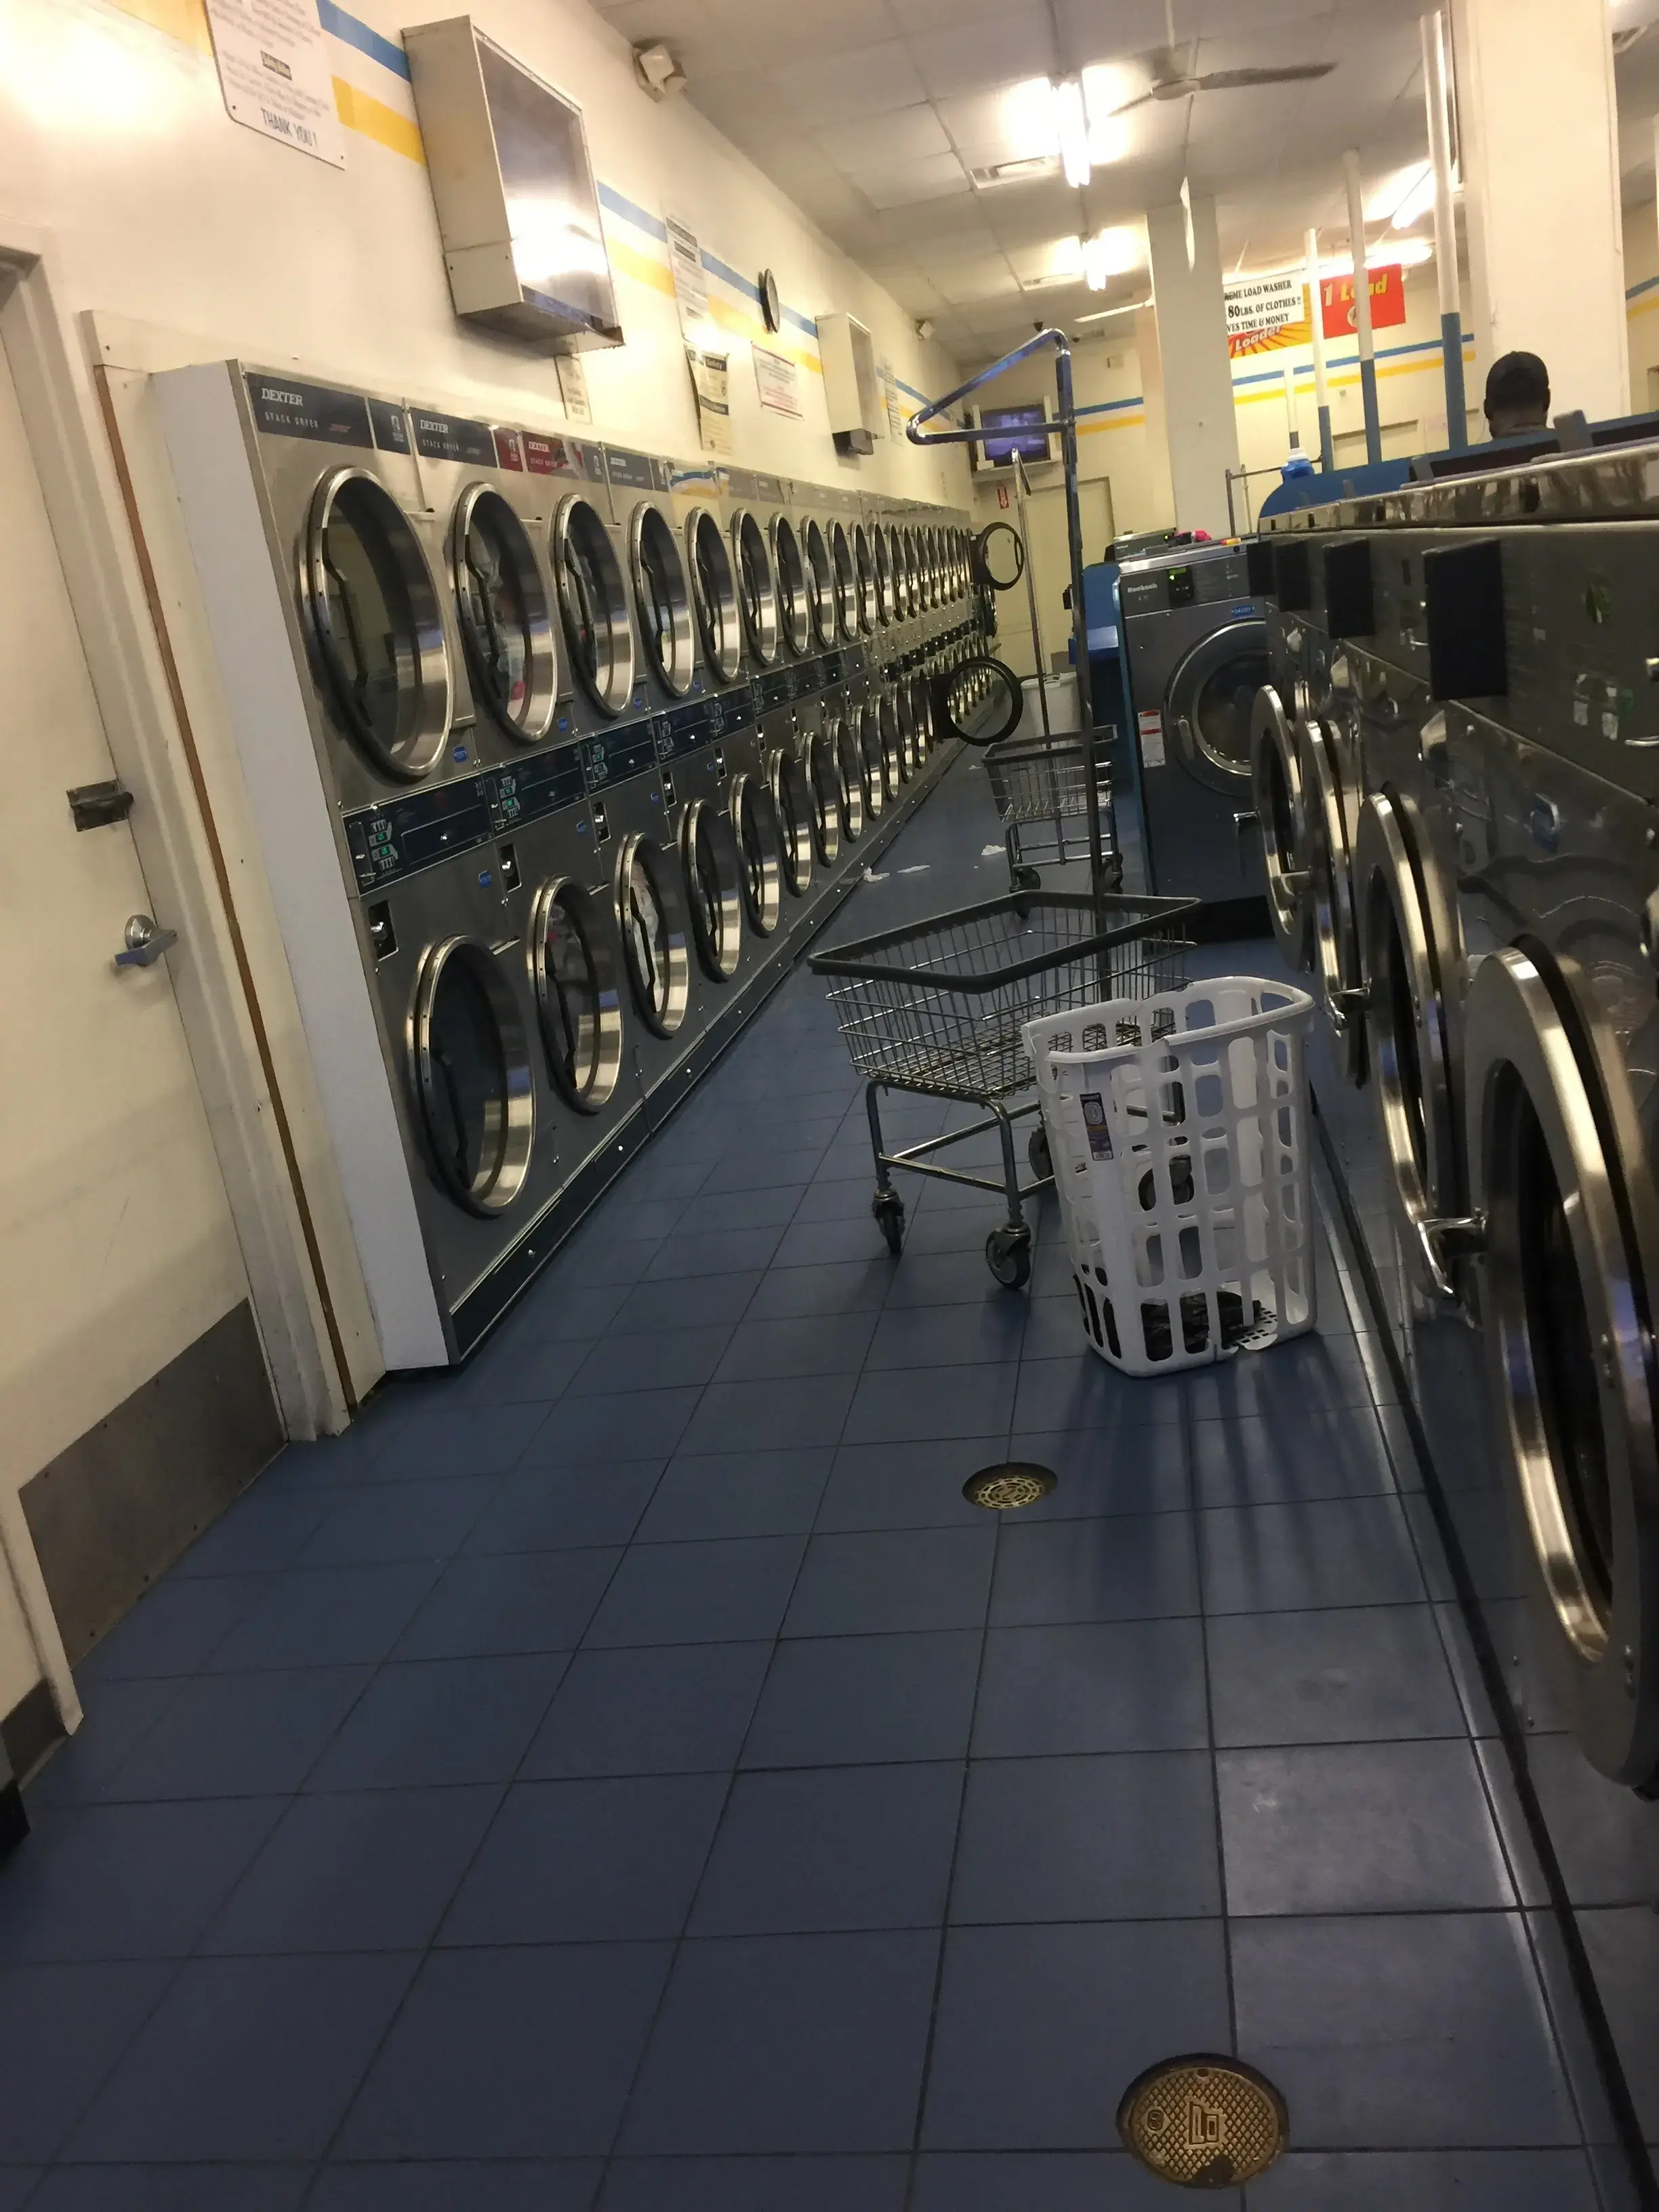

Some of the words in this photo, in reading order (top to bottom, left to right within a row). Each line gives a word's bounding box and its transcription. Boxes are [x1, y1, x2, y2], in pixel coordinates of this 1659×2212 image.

[260, 106, 293, 137] THANK
[293, 123, 312, 146] YOU
[1244, 285, 1262, 298] LOAD
[1263, 279, 1292, 293] WASHER
[1324, 283, 1333, 306] 1
[1255, 303, 1265, 312] OF
[1265, 297, 1296, 311] CLOTHES
[1241, 319, 1258, 331] TIME
[1258, 316, 1265, 327] &
[1265, 312, 1290, 325] MONEY
[1235, 325, 1283, 352] Loader
[262, 388, 304, 406] DEXTER
[264, 411, 291, 424] STACK
[295, 416, 319, 428] DRYER
[419, 419, 449, 433] DEXTER
[422, 439, 441, 449] STACK
[529, 441, 550, 452] DEXTER
